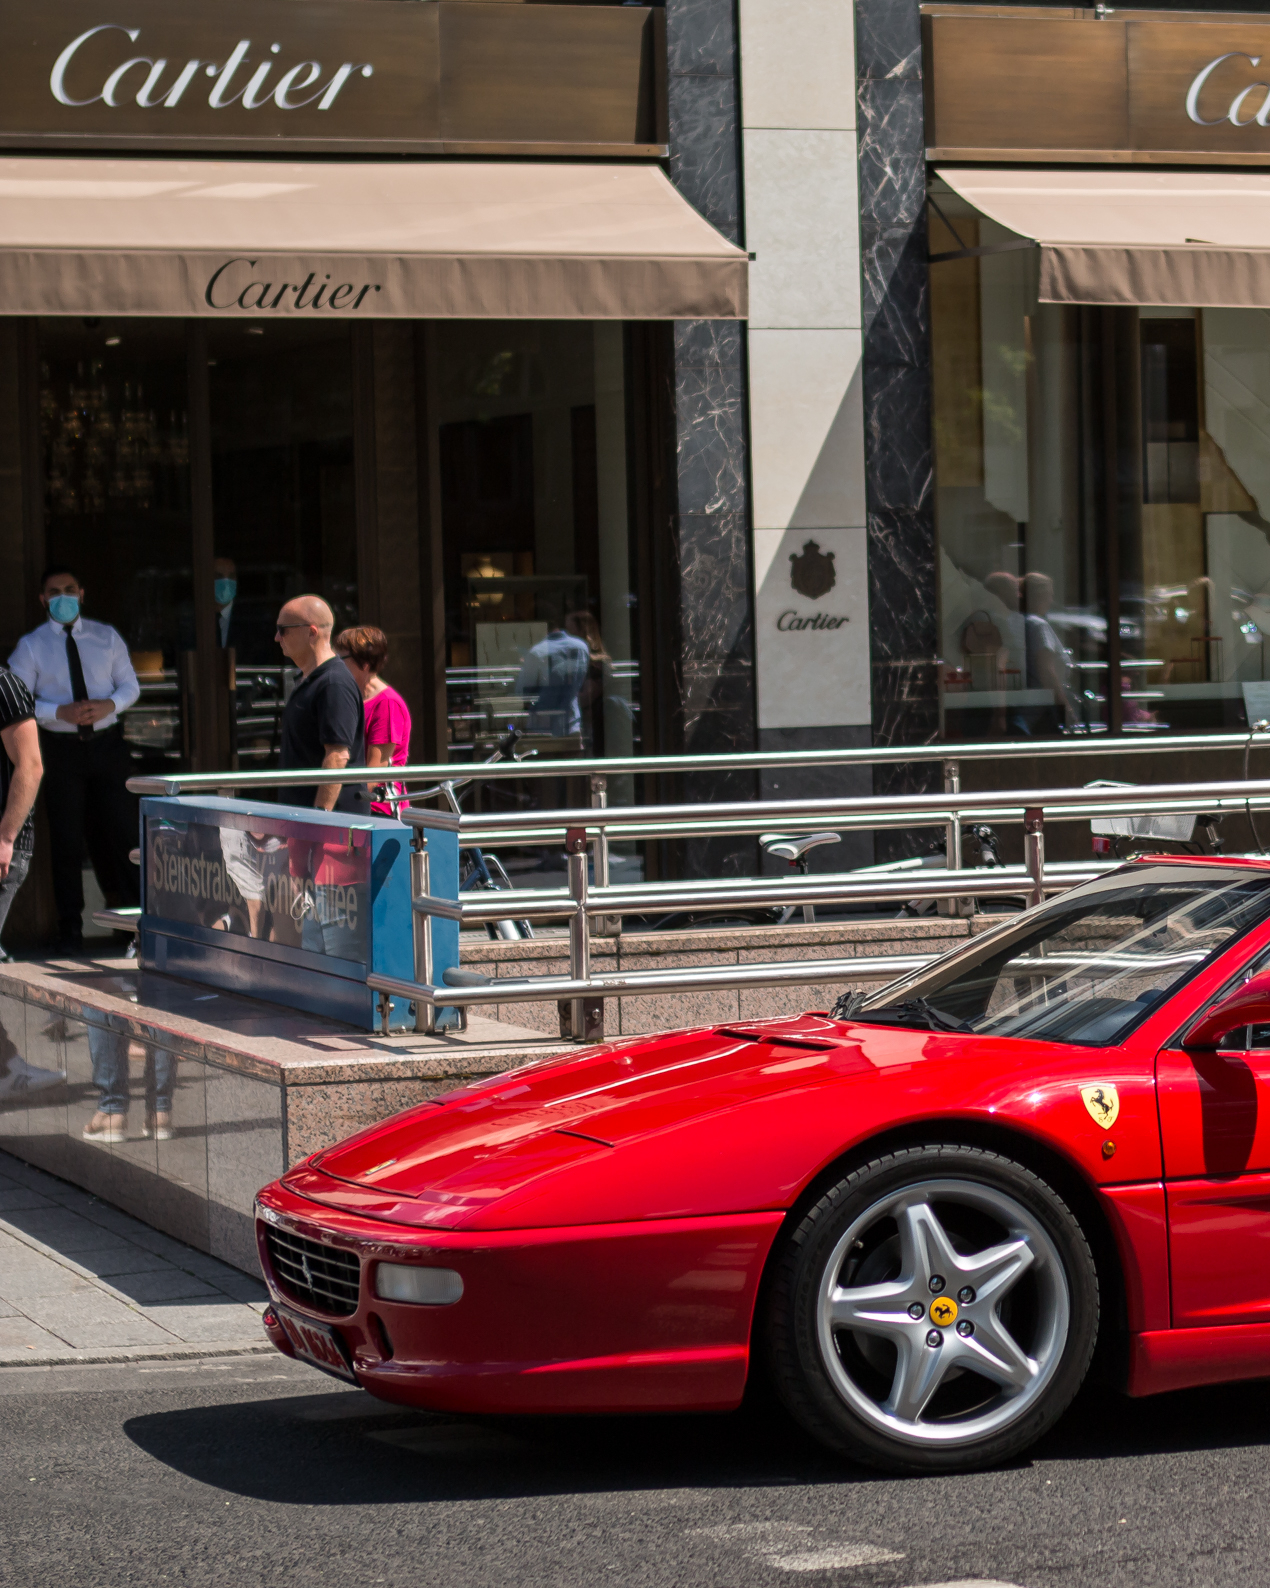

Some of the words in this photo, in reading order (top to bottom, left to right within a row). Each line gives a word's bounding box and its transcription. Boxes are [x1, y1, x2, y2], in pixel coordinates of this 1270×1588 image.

[50, 24, 373, 110] Cartier
[205, 259, 381, 311] Cartier
[776, 609, 850, 632] Cartier
